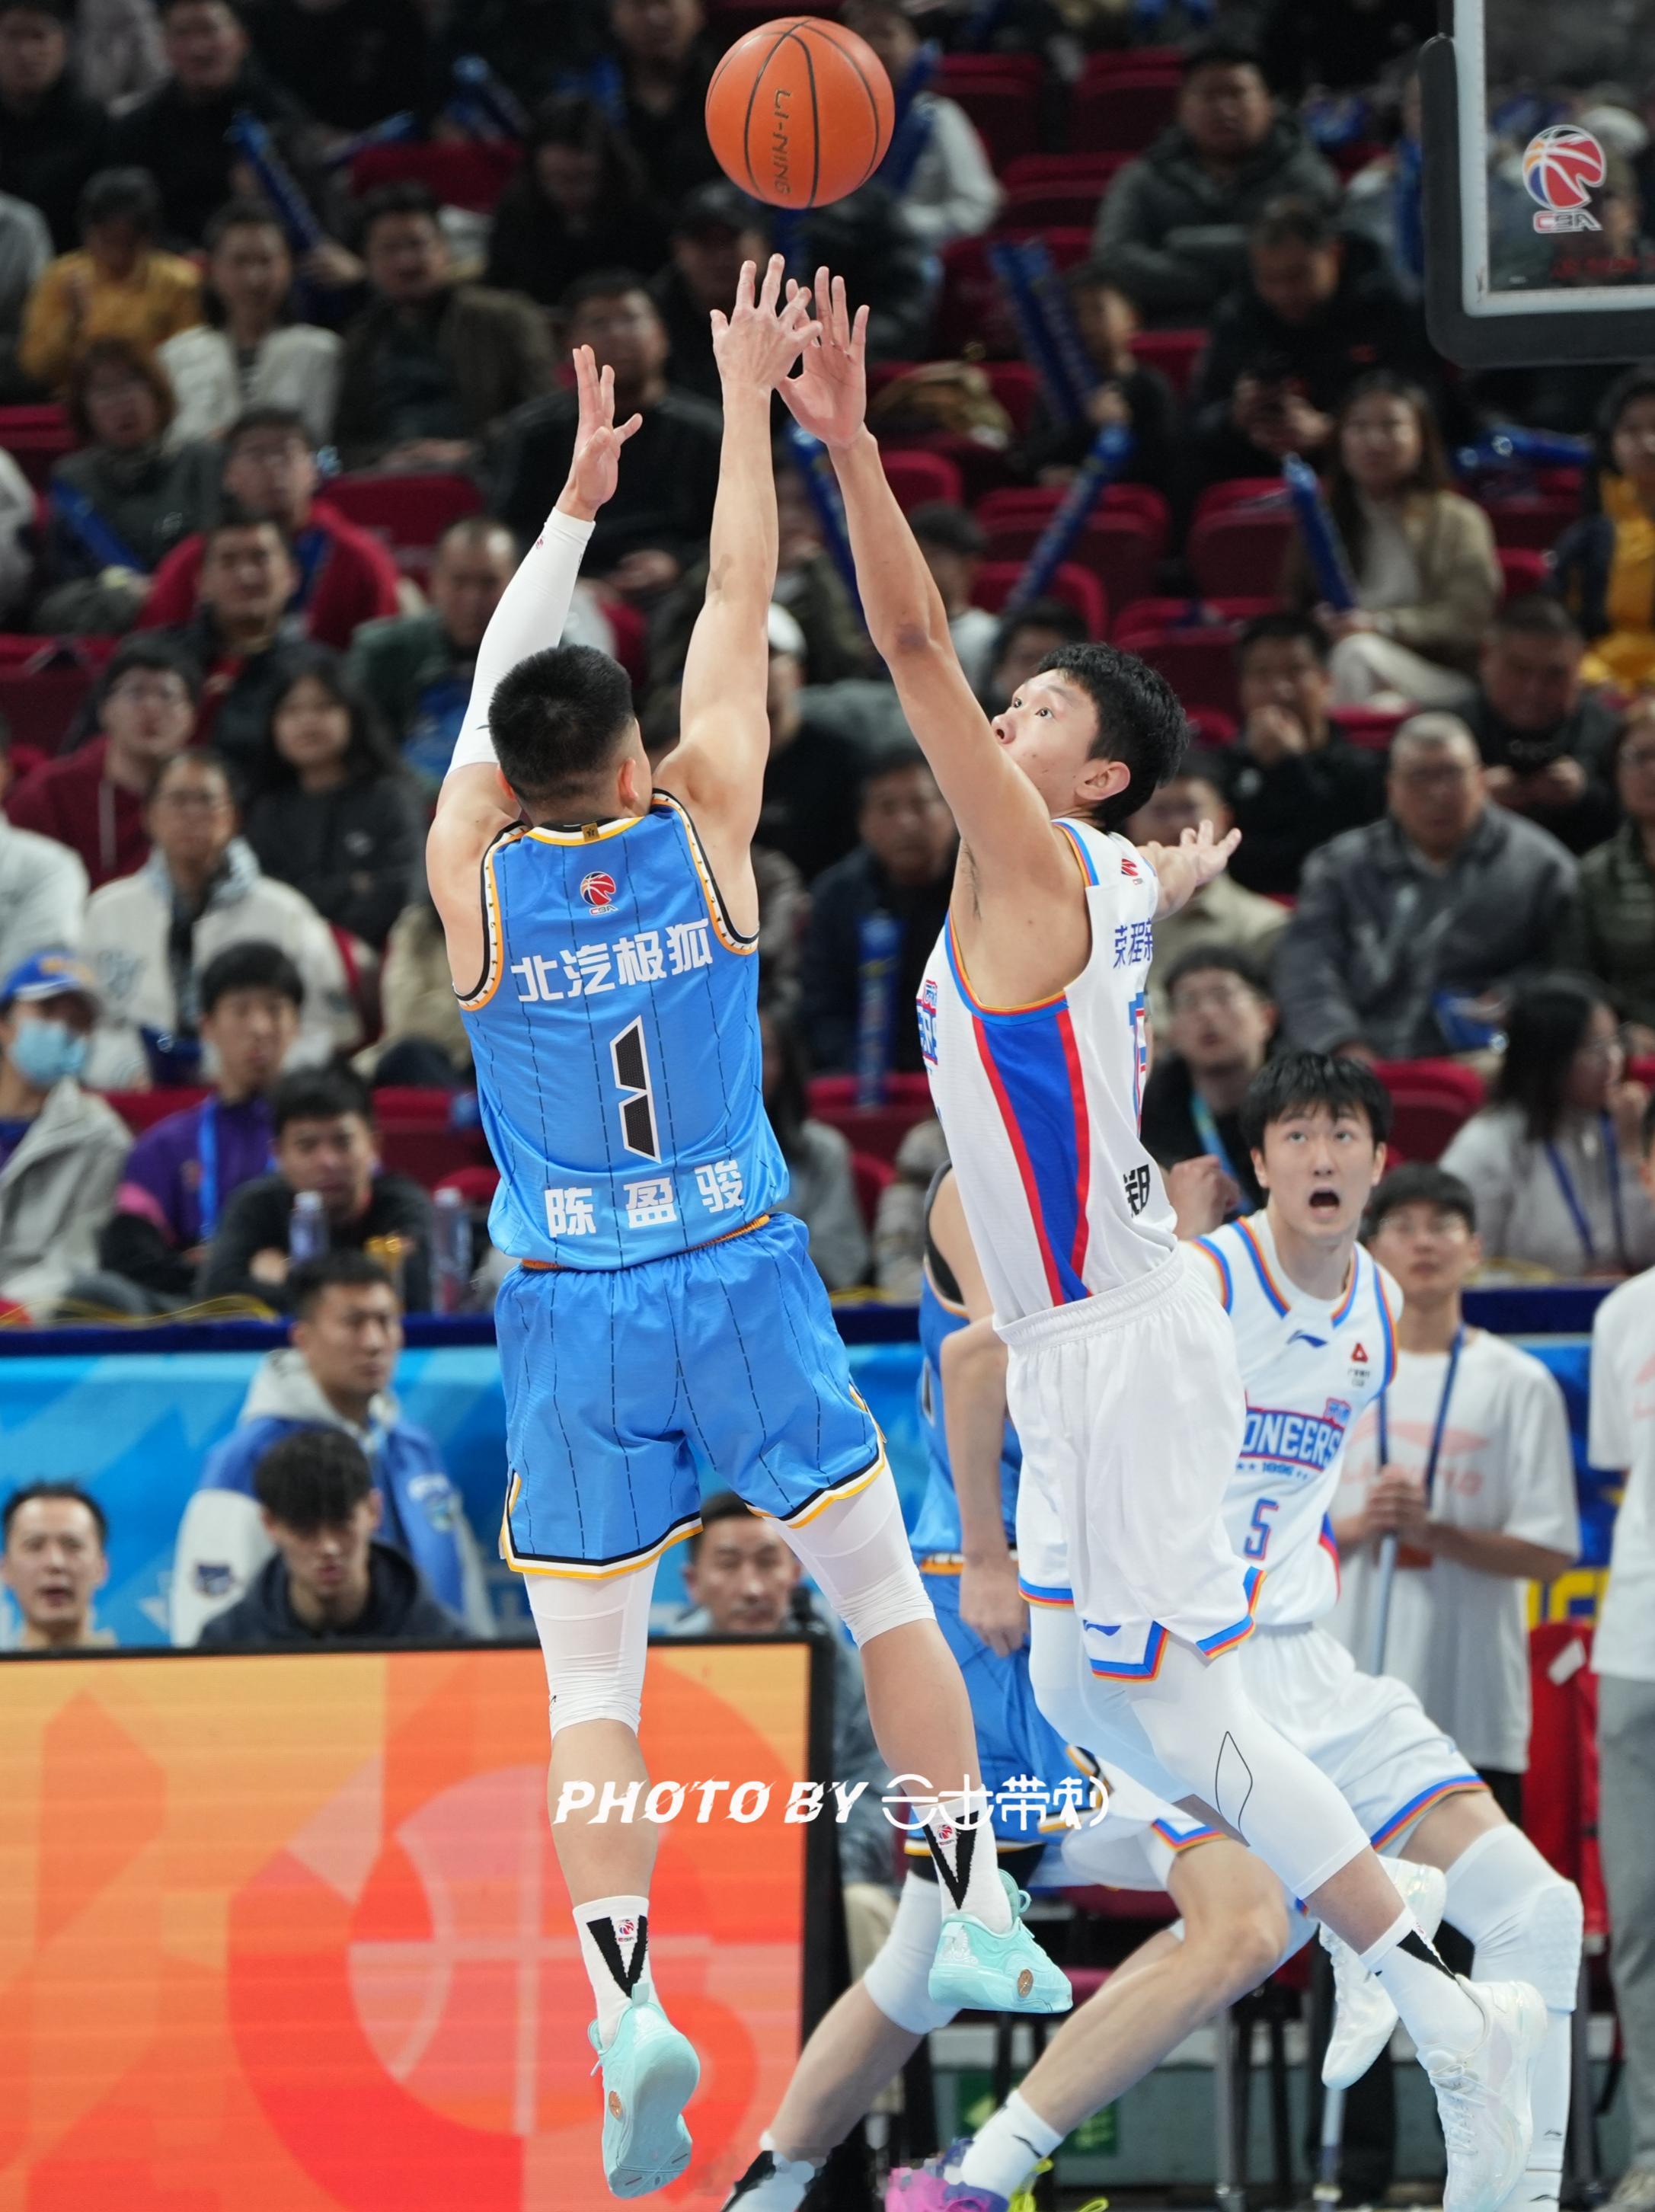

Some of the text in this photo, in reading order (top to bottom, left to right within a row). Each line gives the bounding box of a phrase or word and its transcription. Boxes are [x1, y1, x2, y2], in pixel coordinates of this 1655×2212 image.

[772, 89, 791, 194] LI-NING
[1534, 209, 1602, 233] CBA
[589, 905, 618, 917] CBA
[510, 918, 713, 1002] 北汽极狐
[545, 1160, 744, 1238] 陈盈骏
[1243, 1411, 1343, 1467] ONEERS
[1244, 1498, 1280, 1562] 5
